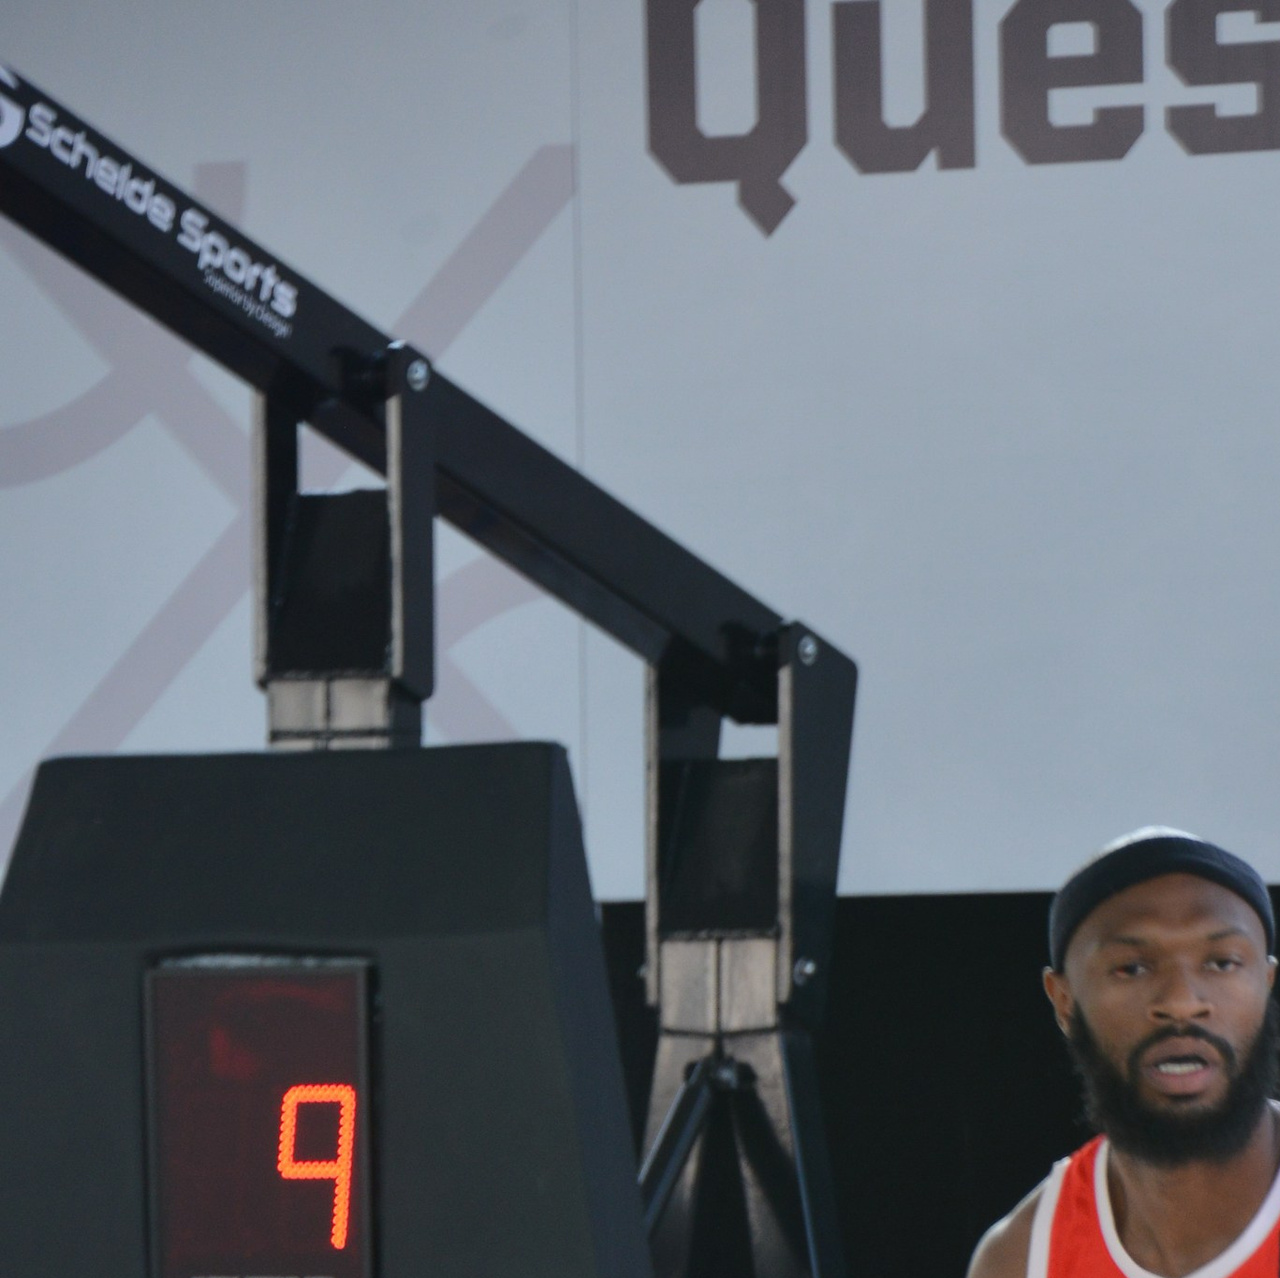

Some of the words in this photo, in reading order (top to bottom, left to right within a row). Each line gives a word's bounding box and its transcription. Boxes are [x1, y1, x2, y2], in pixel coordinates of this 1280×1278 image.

[25, 102, 176, 233] Schelde
[177, 207, 298, 318] Sports
[278, 1084, 356, 1250] 9
